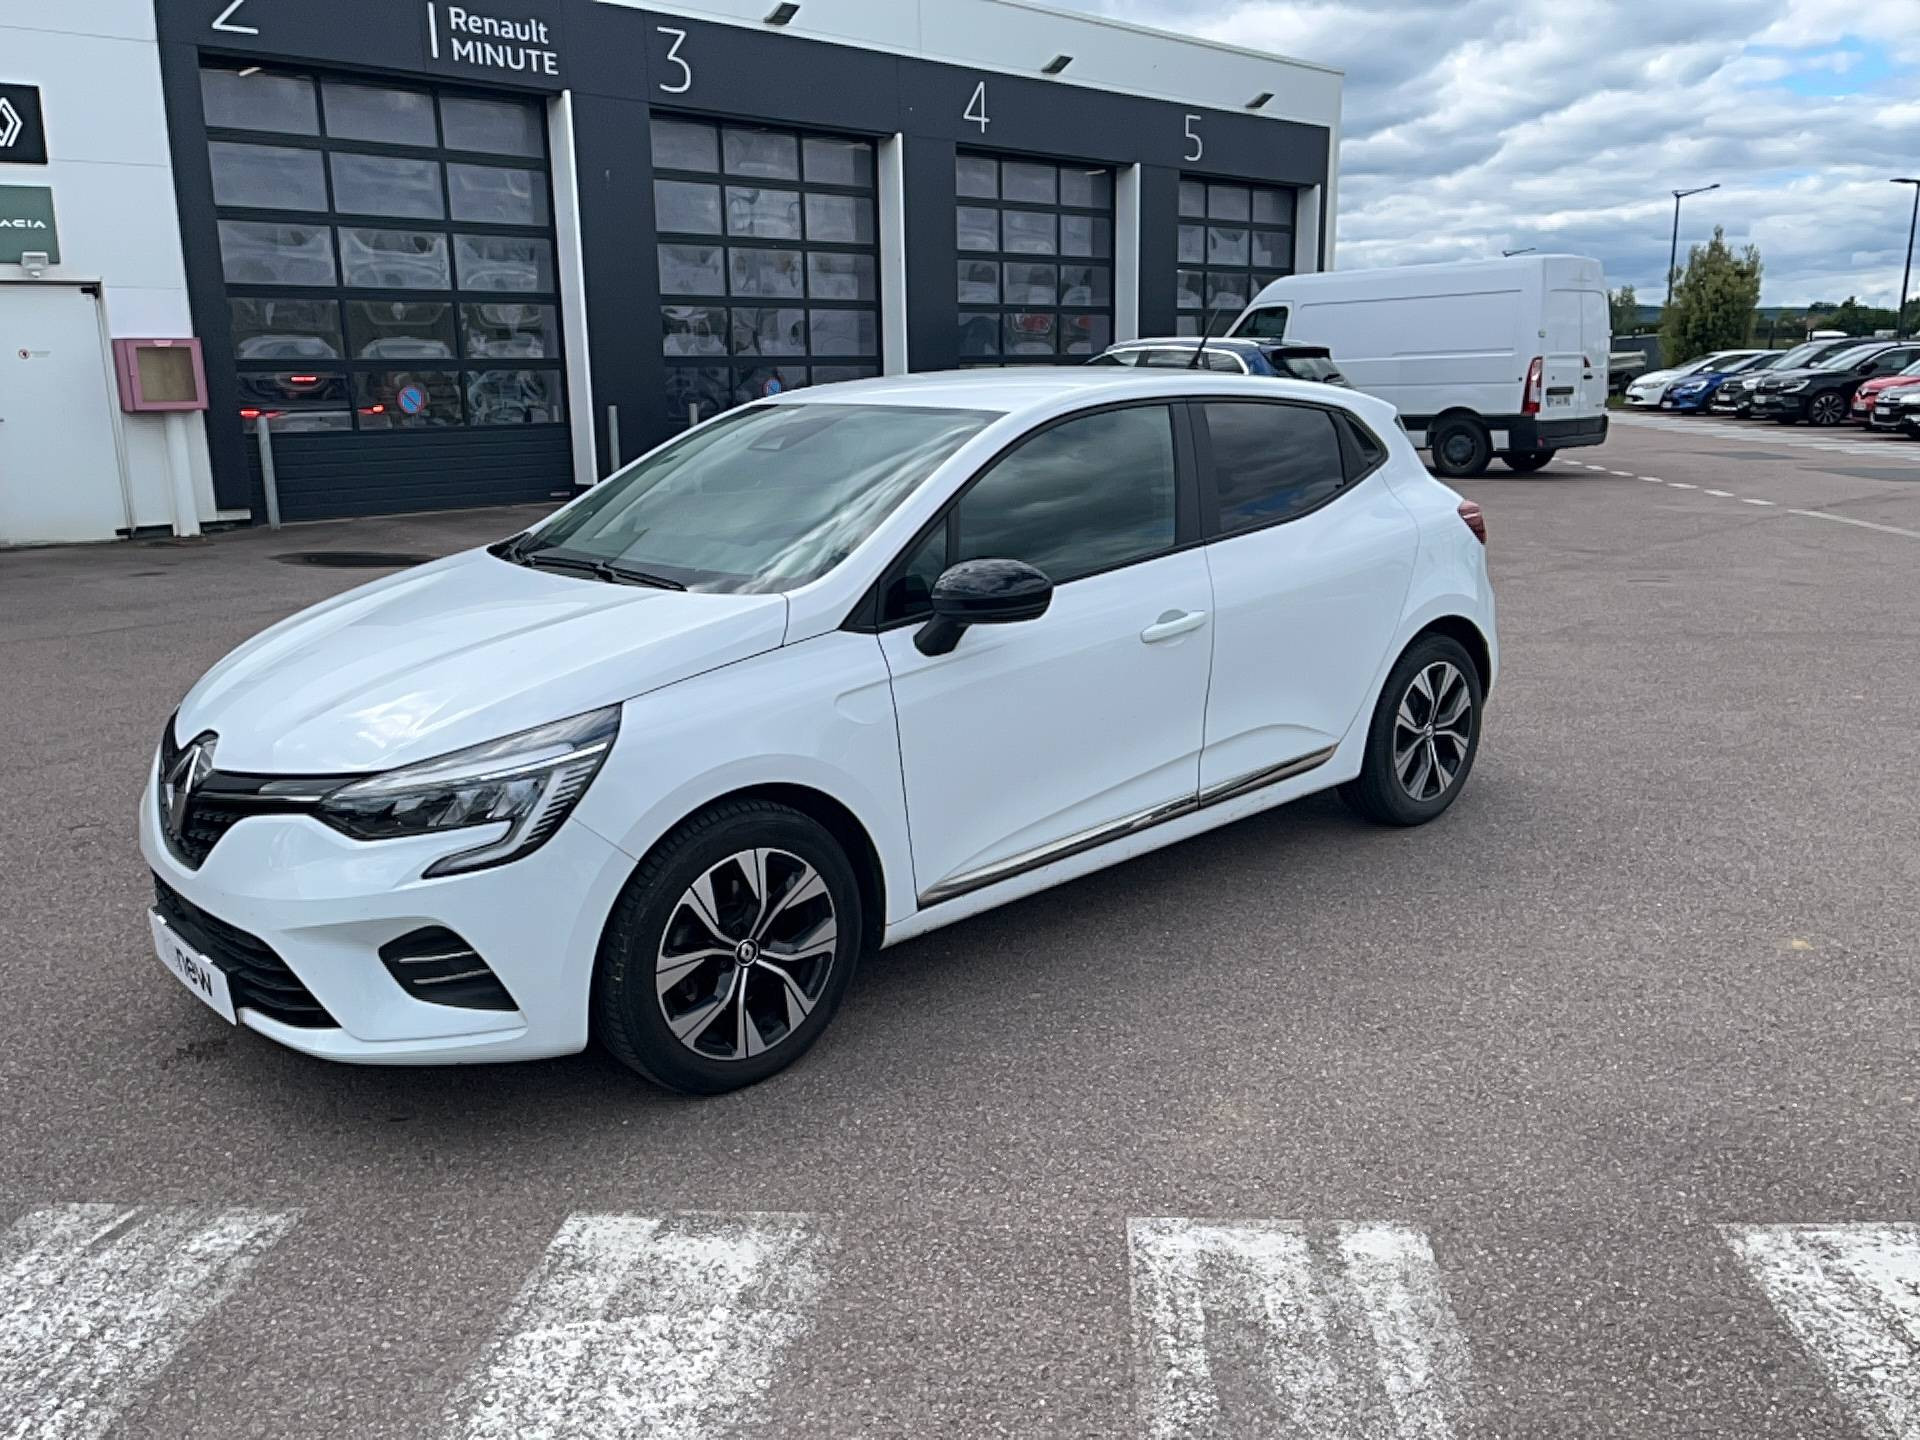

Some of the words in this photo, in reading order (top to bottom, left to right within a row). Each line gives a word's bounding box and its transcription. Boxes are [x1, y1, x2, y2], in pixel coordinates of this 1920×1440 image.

[448, 6, 550, 45] Renault
[451, 37, 559, 75] MINUTE
[656, 26, 692, 93] 3
[963, 80, 990, 134] 4
[1184, 114, 1203, 161] 5
[0, 219, 47, 229] ACIA
